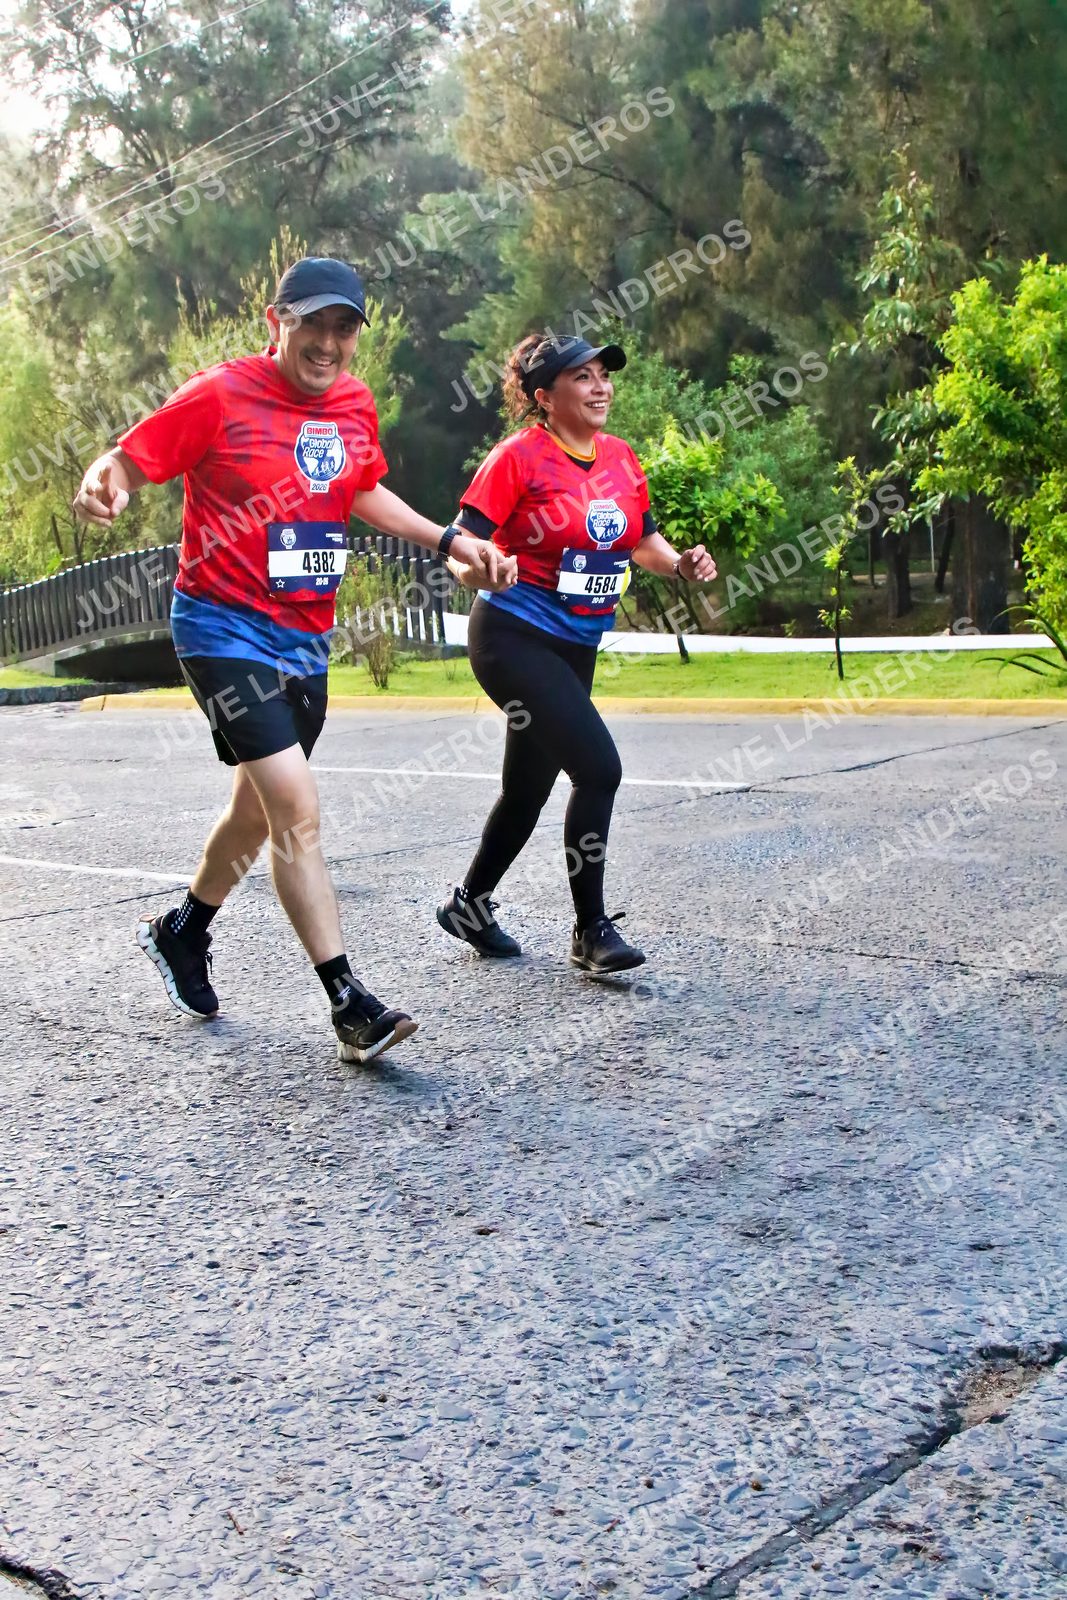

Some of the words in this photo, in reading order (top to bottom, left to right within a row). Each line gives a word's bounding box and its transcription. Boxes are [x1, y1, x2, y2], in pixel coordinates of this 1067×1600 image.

[306, 427, 333, 436] BIMBO
[309, 438, 334, 449] Global
[303, 446, 324, 458] Race
[302, 551, 335, 573] 4382
[585, 576, 617, 594] 4584
